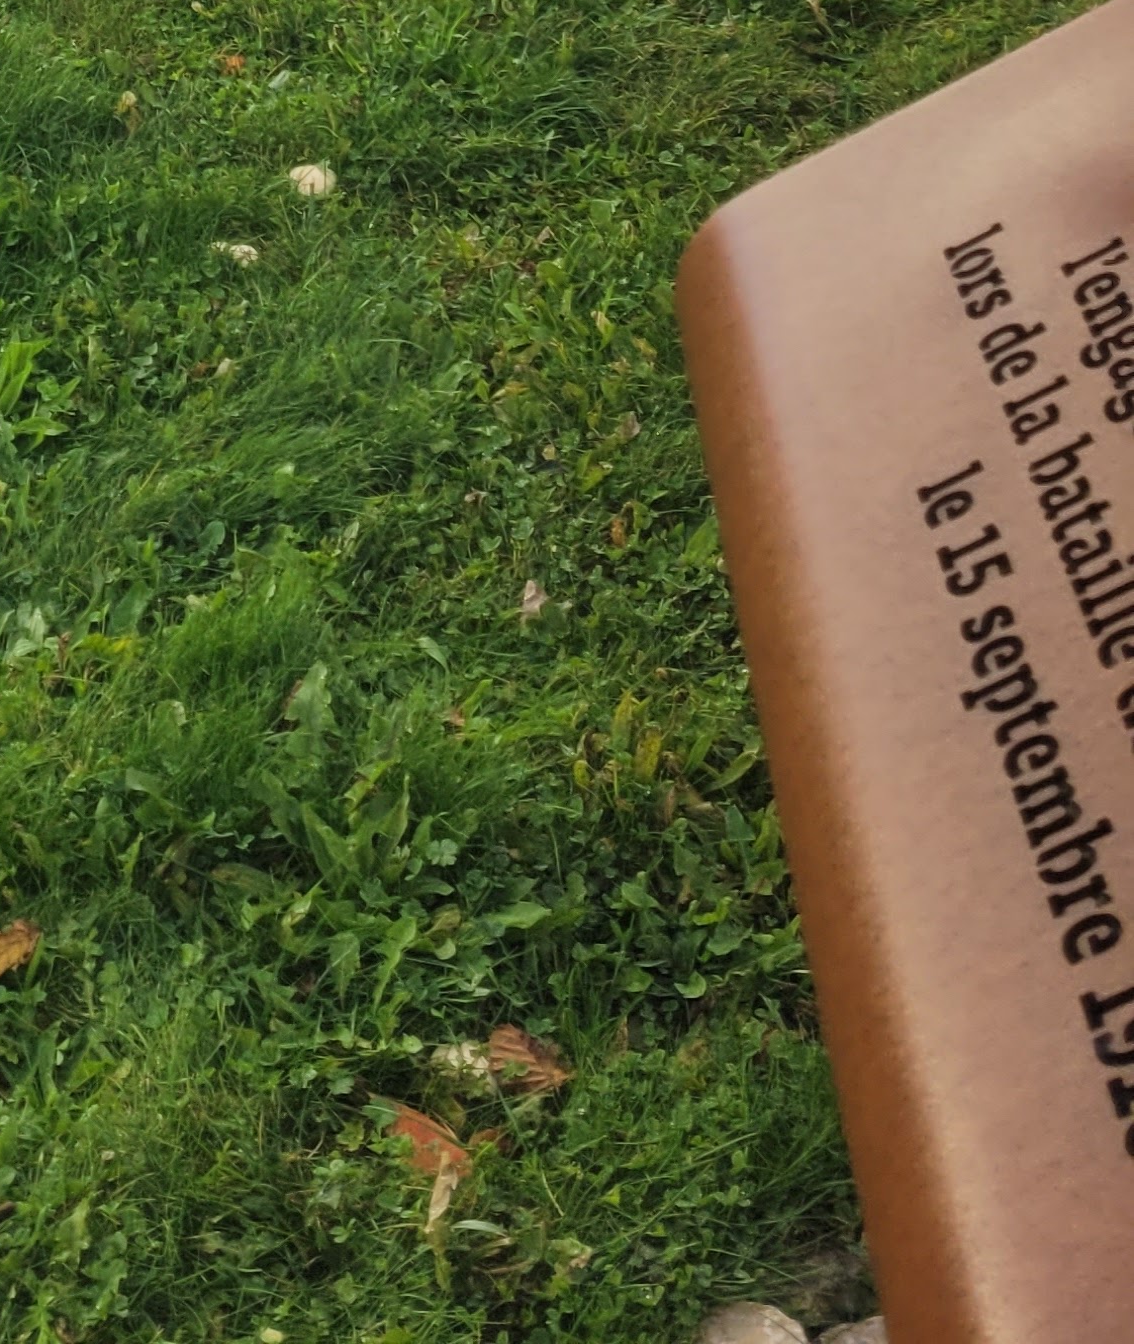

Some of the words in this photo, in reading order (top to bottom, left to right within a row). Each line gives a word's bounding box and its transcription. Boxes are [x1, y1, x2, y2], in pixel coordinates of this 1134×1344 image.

[943, 222, 1013, 320] lors
[979, 321, 1047, 386] de
[1002, 374, 1070, 446] la
[916, 459, 984, 529] le
[935, 523, 1014, 597] 15
[1028, 432, 1134, 670] bataille
[960, 604, 1125, 966] septembre
